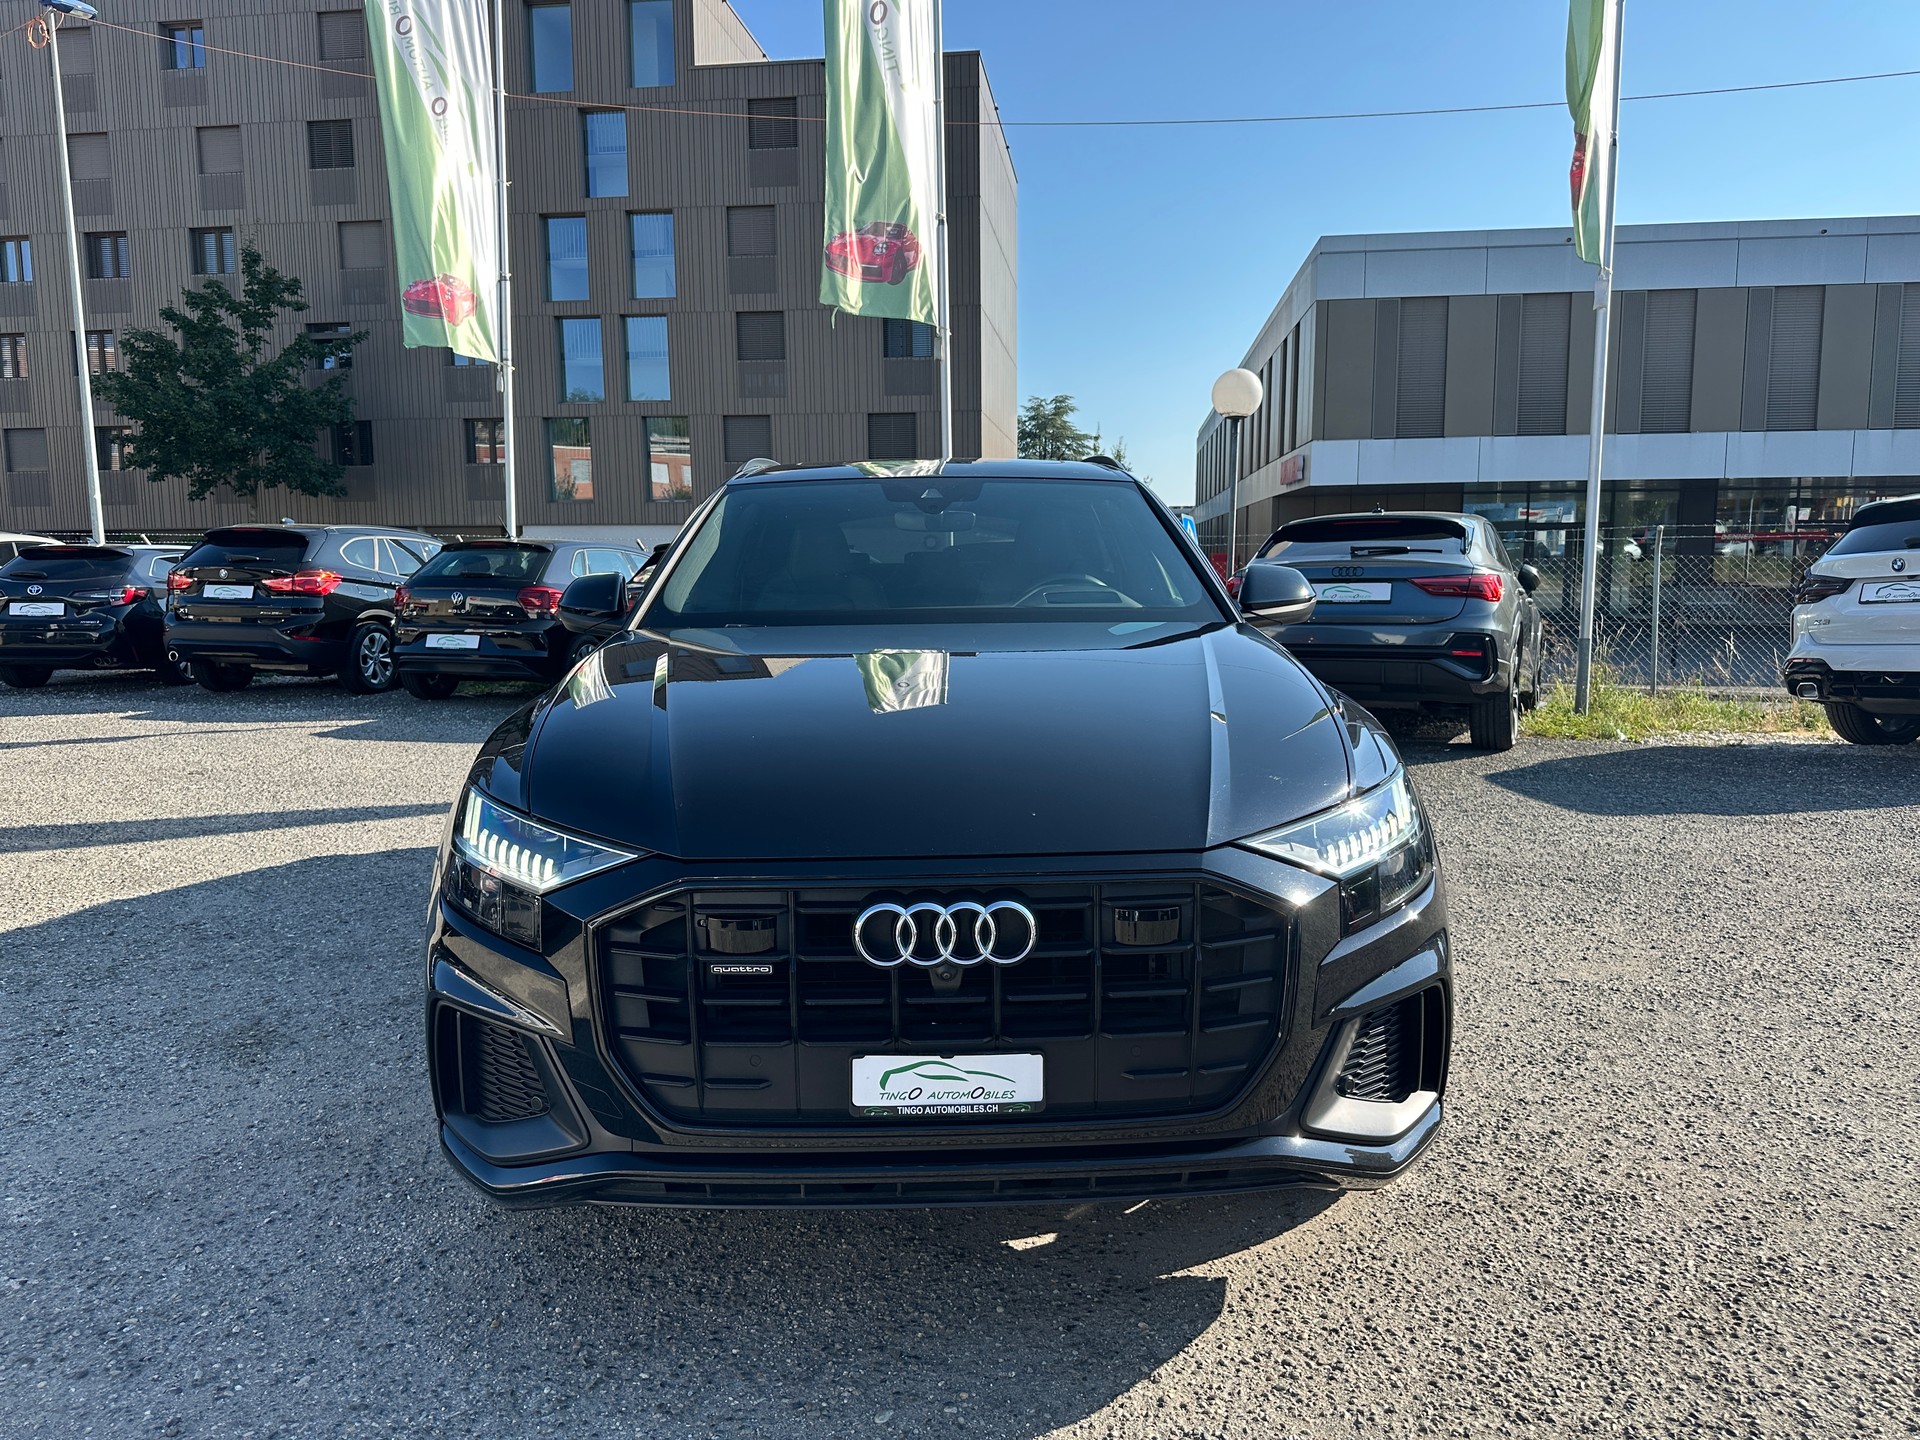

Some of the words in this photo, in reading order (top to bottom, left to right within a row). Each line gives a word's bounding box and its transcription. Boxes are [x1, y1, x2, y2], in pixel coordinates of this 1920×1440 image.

[879, 1087, 922, 1101] TINGO
[927, 1086, 1016, 1100] AUTOMOBILES
[897, 1106, 923, 1115] TINGO
[924, 1104, 998, 1114] AUTOMOBILES.CH
